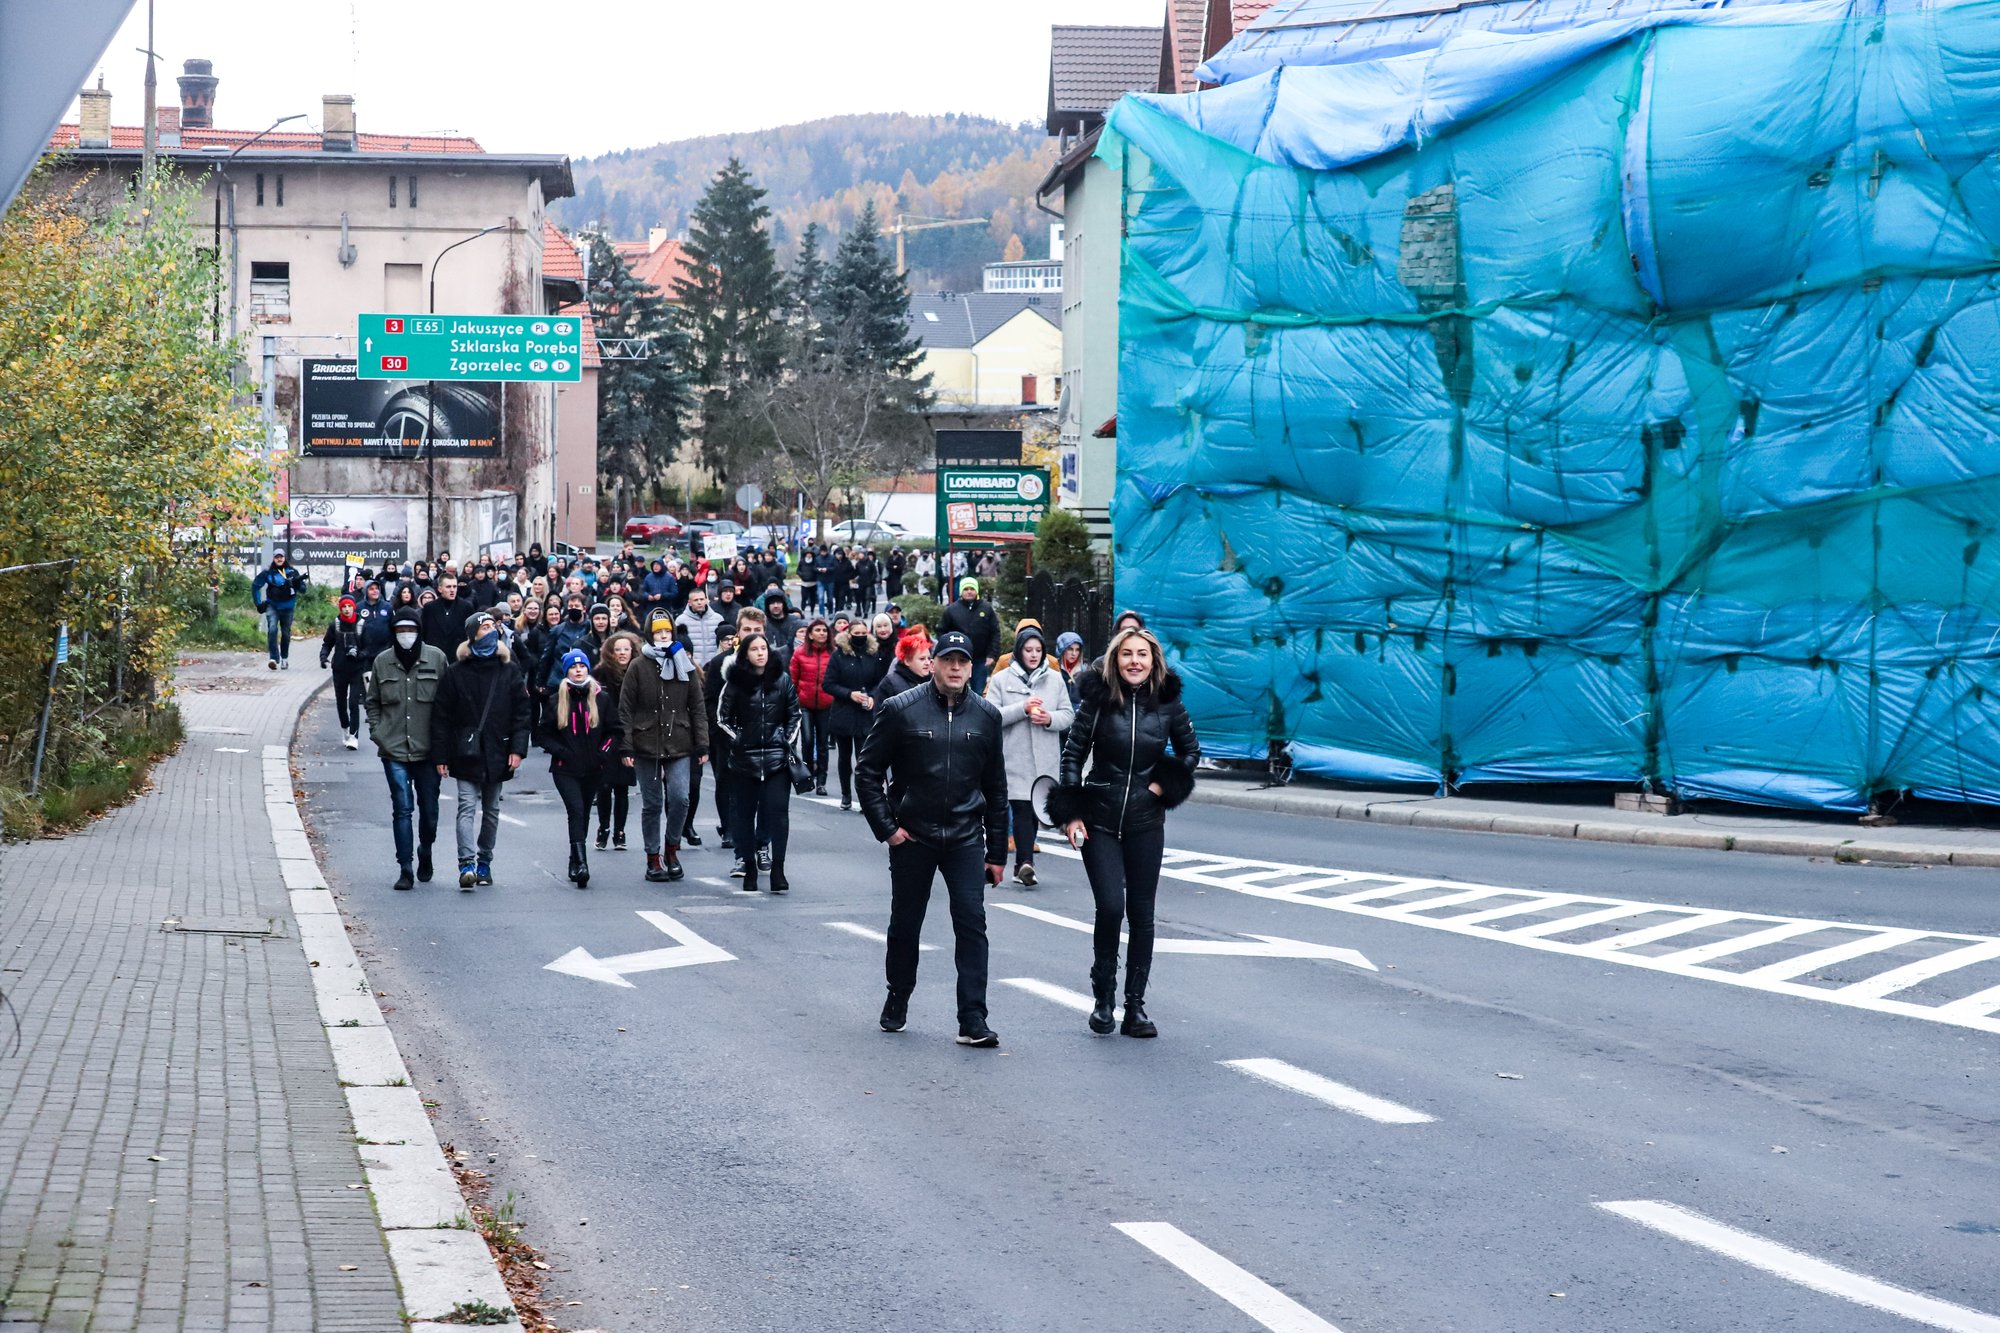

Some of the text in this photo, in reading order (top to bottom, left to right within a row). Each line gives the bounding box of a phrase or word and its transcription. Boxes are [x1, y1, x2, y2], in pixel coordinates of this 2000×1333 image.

[391, 321, 398, 331] 3
[450, 321, 524, 338] Jakuszyce
[533, 324, 545, 333] PL
[556, 324, 569, 333] CZ
[450, 340, 578, 357] Szklarska Poręba
[312, 364, 358, 373] BRIDGEST
[387, 358, 565, 374] 30 Zgorzelec PL D
[425, 438, 460, 448] PĘDKOŚCIĄ
[949, 477, 1017, 488] LOOMBARD
[802, 522, 810, 532] P
